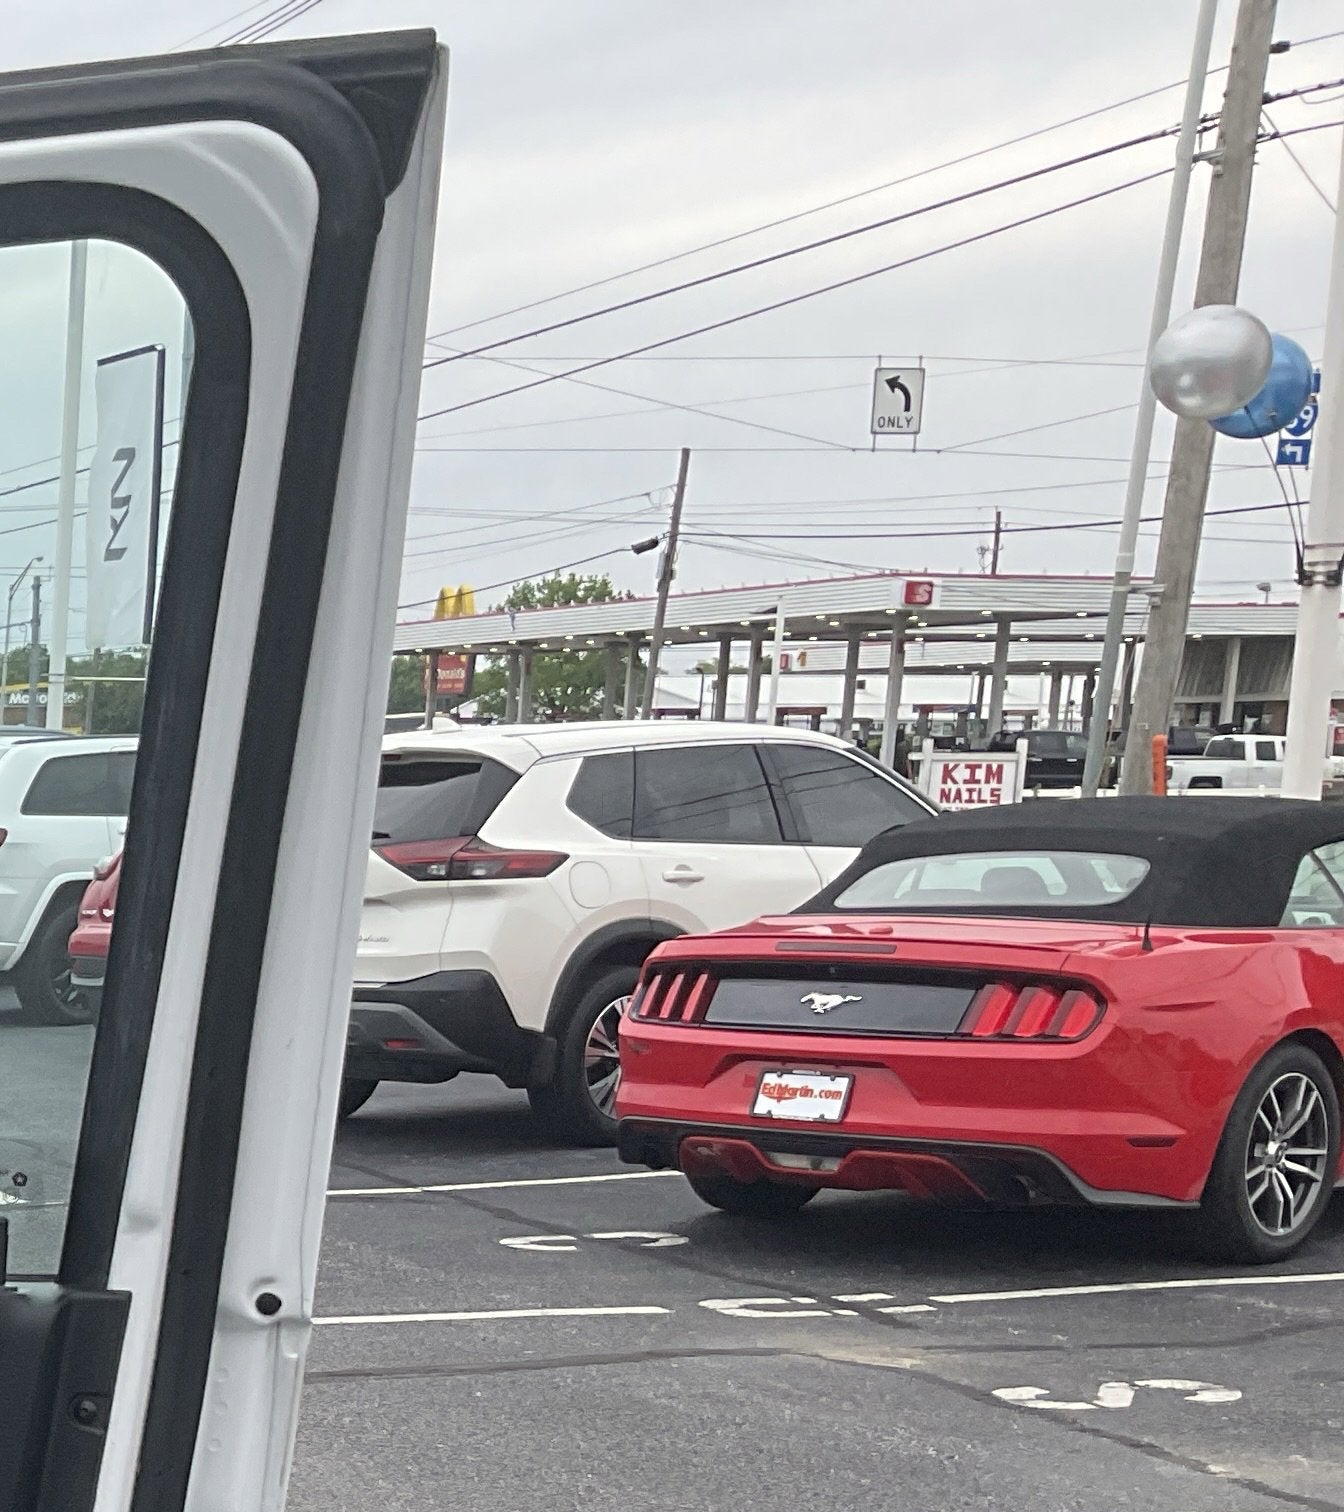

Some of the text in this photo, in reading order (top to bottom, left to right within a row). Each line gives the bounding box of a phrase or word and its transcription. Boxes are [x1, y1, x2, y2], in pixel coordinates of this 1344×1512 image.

[877, 416, 913, 428] ONLY
[941, 763, 1004, 785] KIM
[939, 787, 1002, 804] NAILS
[761, 1082, 843, 1101] EdMartin.com
